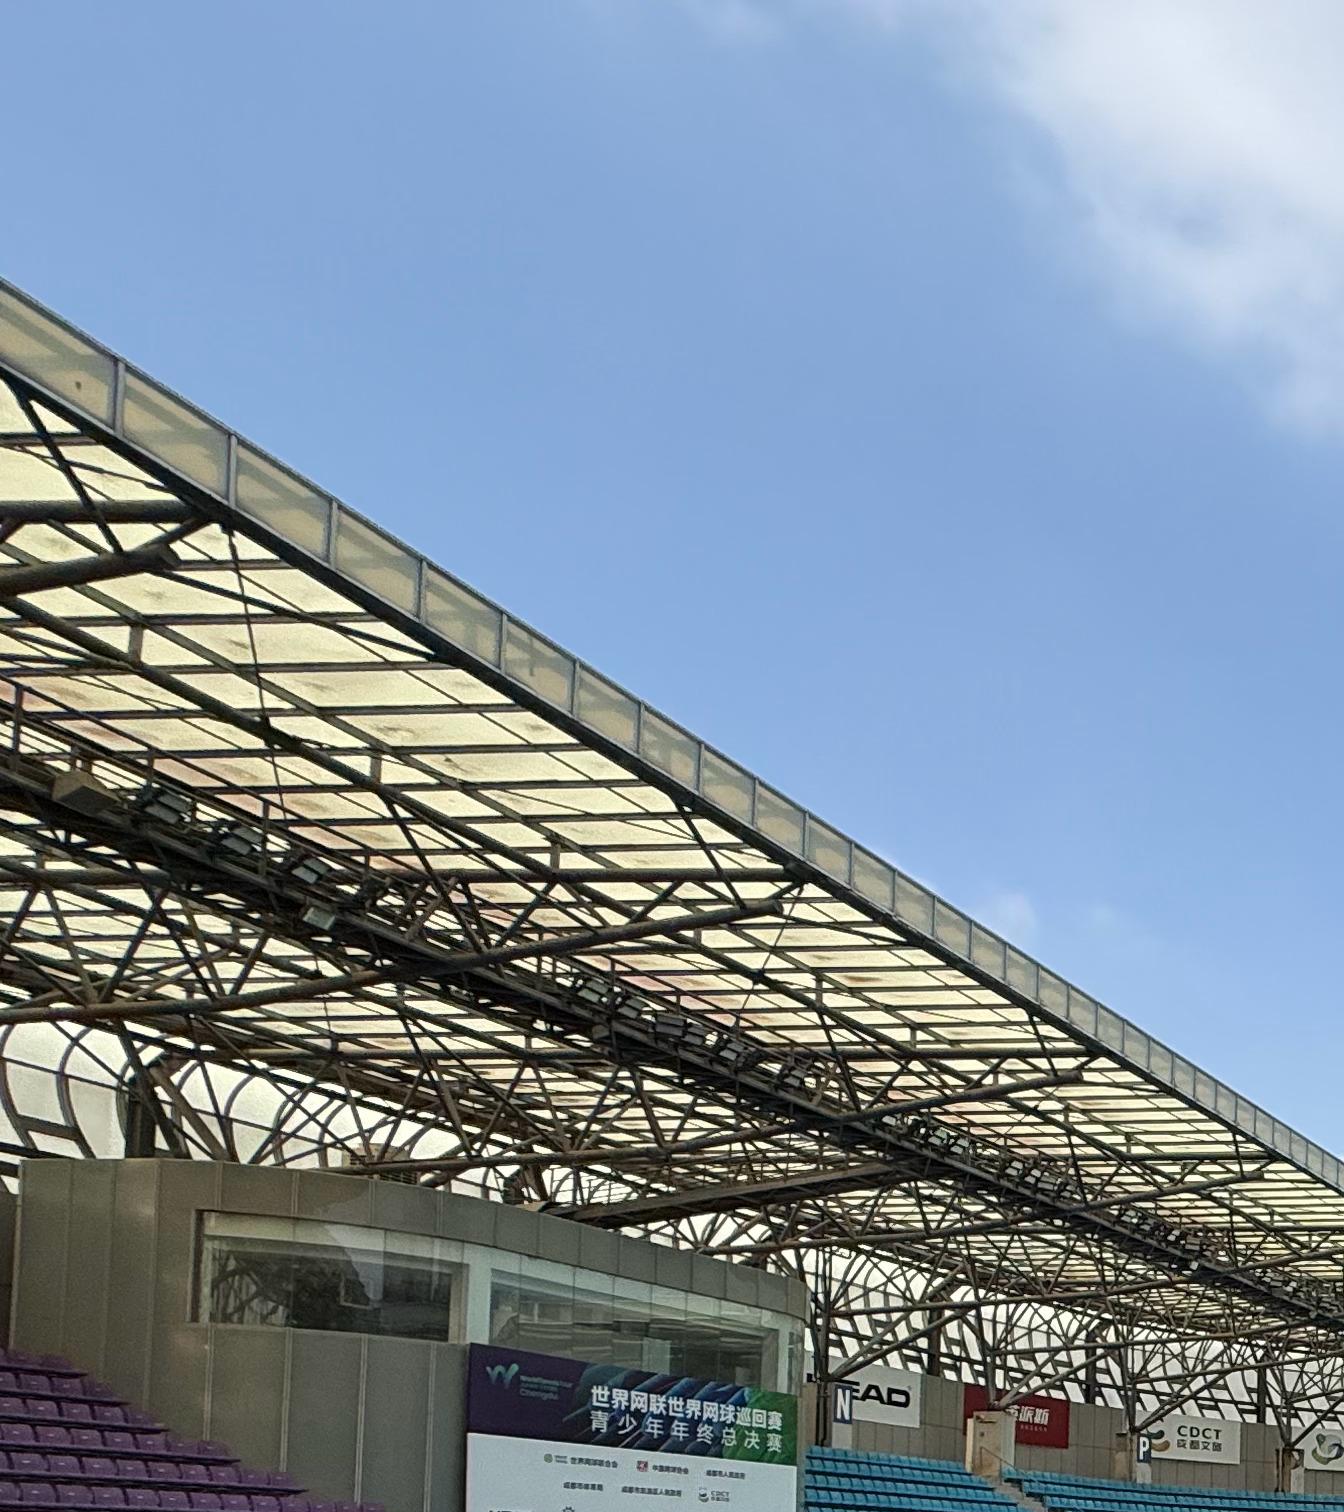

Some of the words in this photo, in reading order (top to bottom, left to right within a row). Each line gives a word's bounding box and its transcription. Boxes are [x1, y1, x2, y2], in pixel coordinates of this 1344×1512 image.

[591, 1385, 783, 1431] 世界网联世界网球巡回赛
[836, 1388, 850, 1419] N
[590, 1410, 782, 1454] 青少年年终总决赛
[1177, 1425, 1223, 1440] CDCT
[1139, 1436, 1150, 1461] P
